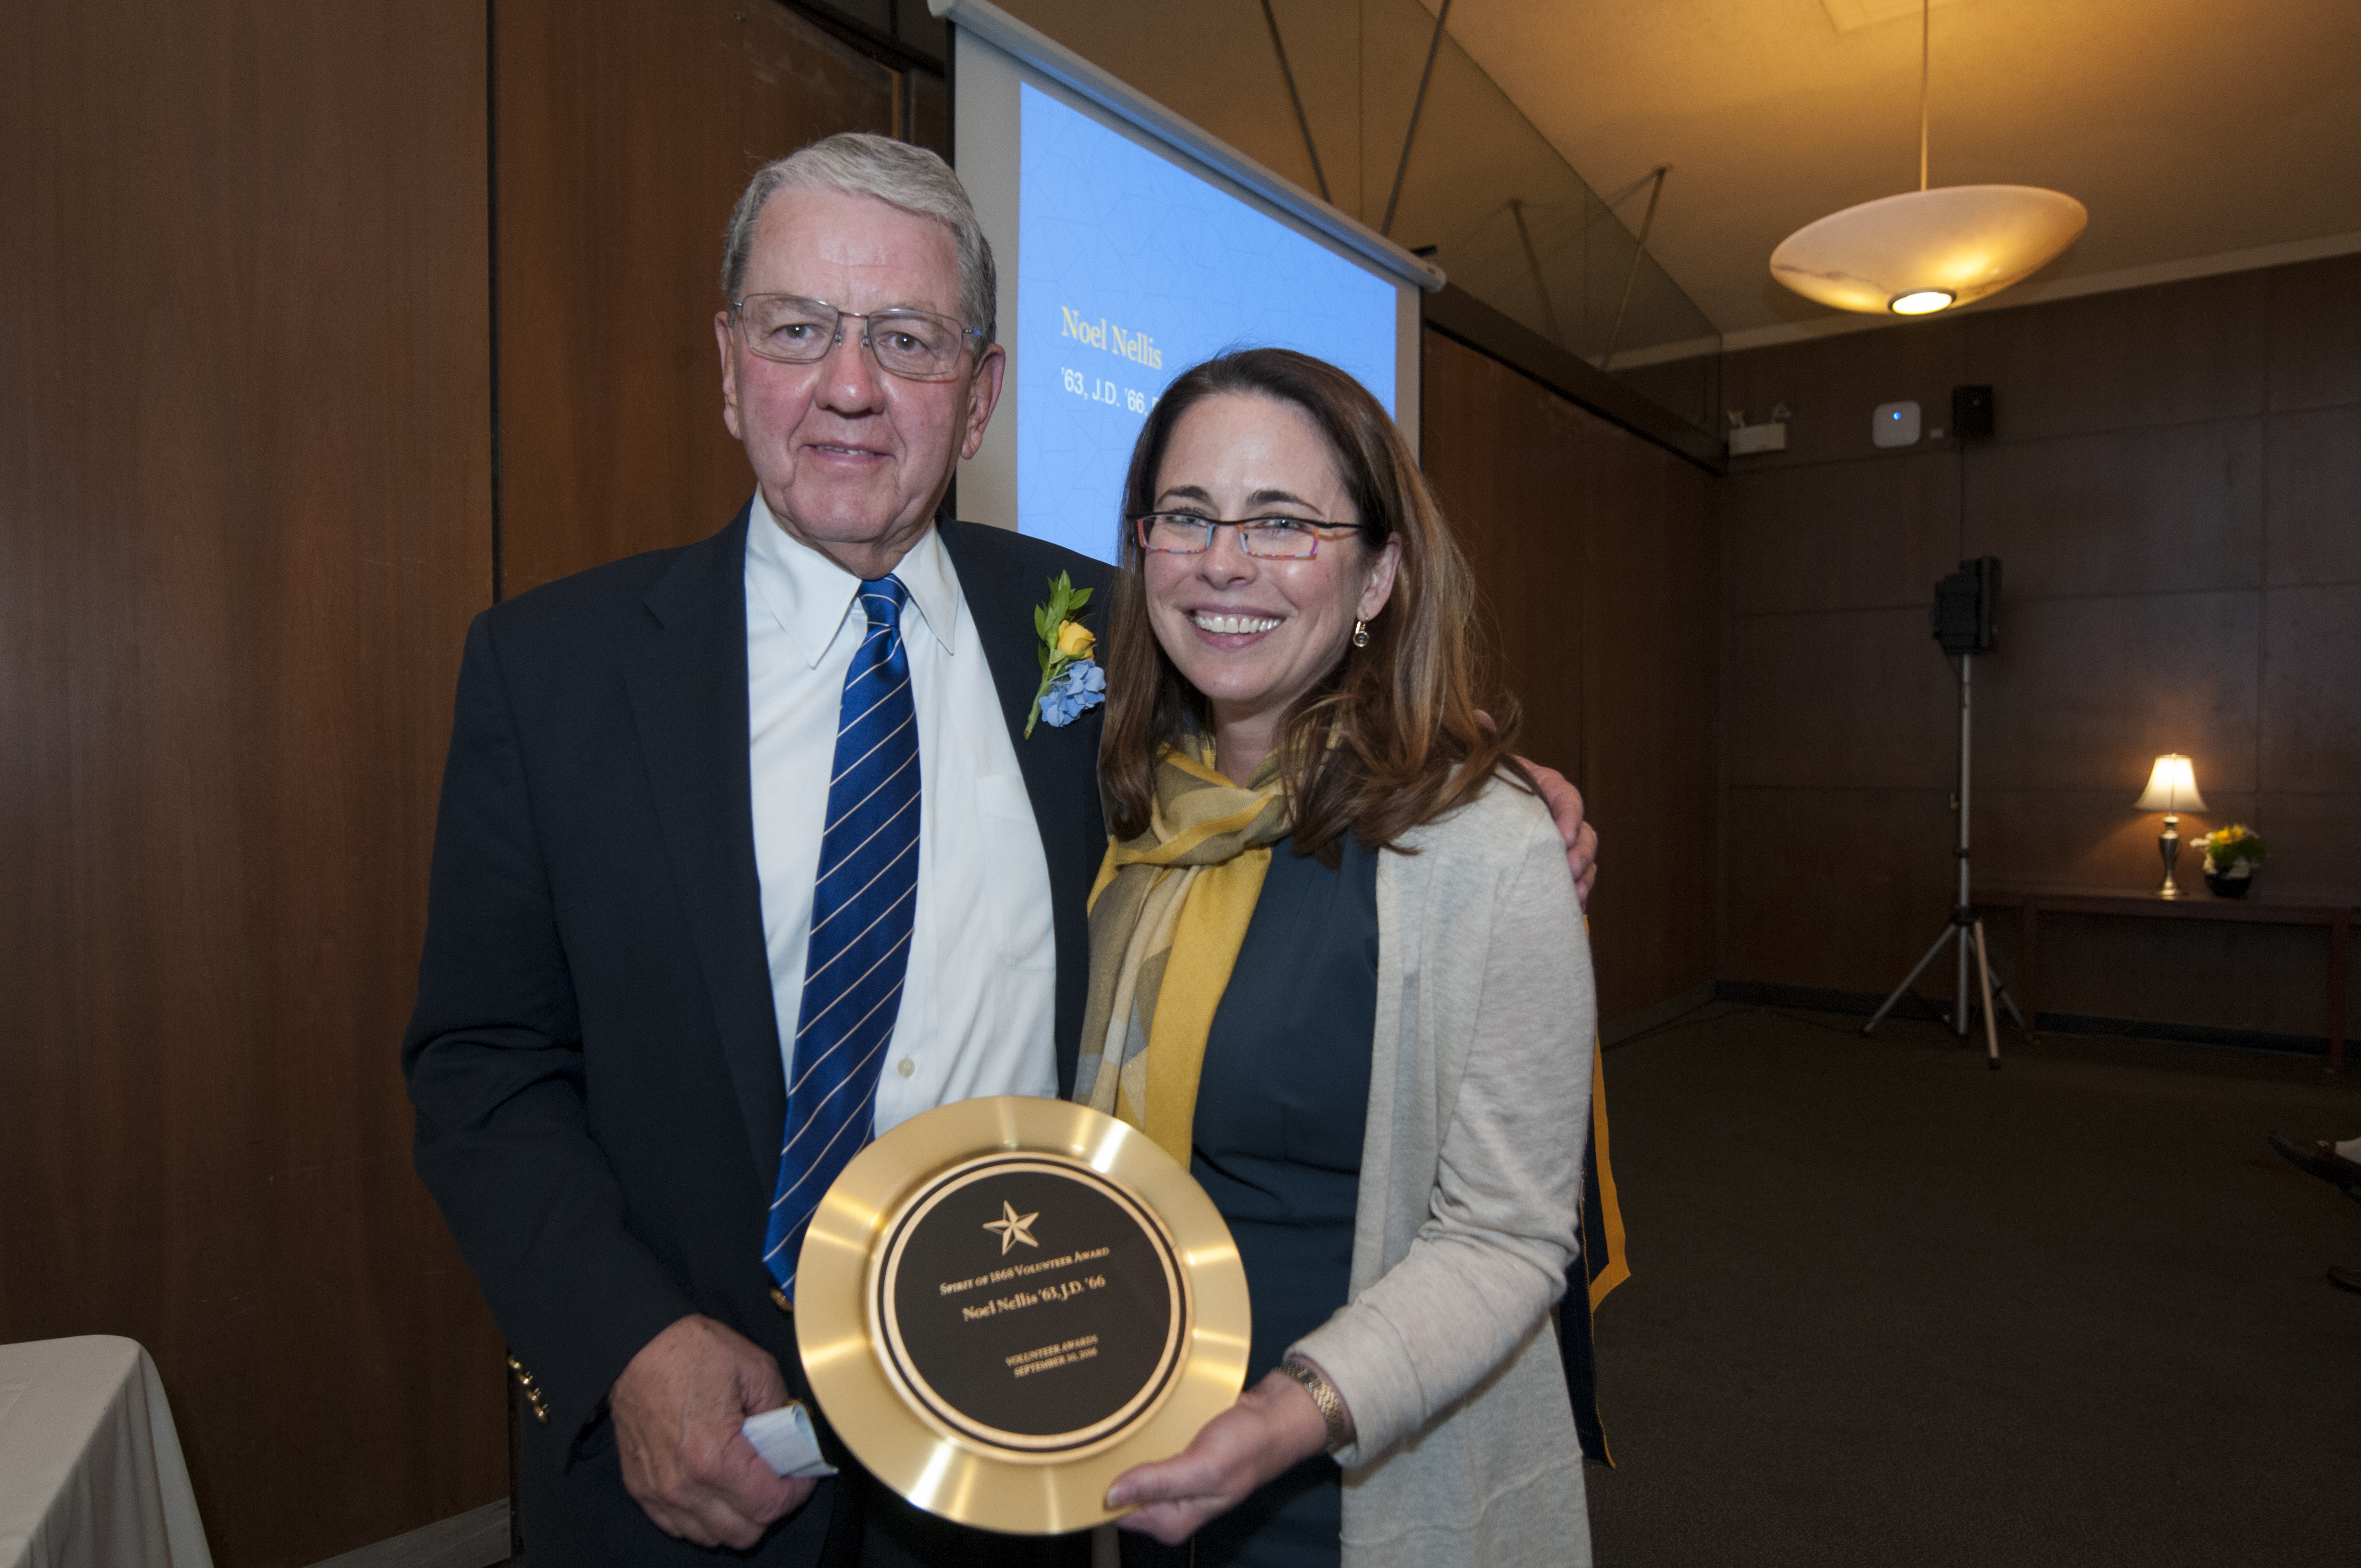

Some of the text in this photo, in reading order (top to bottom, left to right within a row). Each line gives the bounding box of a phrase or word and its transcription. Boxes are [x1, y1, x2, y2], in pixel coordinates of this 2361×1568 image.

[1062, 306, 1162, 369] Noel Nellis
[1061, 367, 1088, 400] '63,
[1092, 378, 1120, 407] J.D.
[990, 1267, 1015, 1283] 1868
[962, 1300, 997, 1321] Noel
[997, 1292, 1038, 1313] Nellis
[1085, 1274, 1106, 1289] '66
[1005, 1334, 1099, 1366] VOLUNTEER AWARDS
[1014, 1355, 1066, 1378] SEPTEMBER
